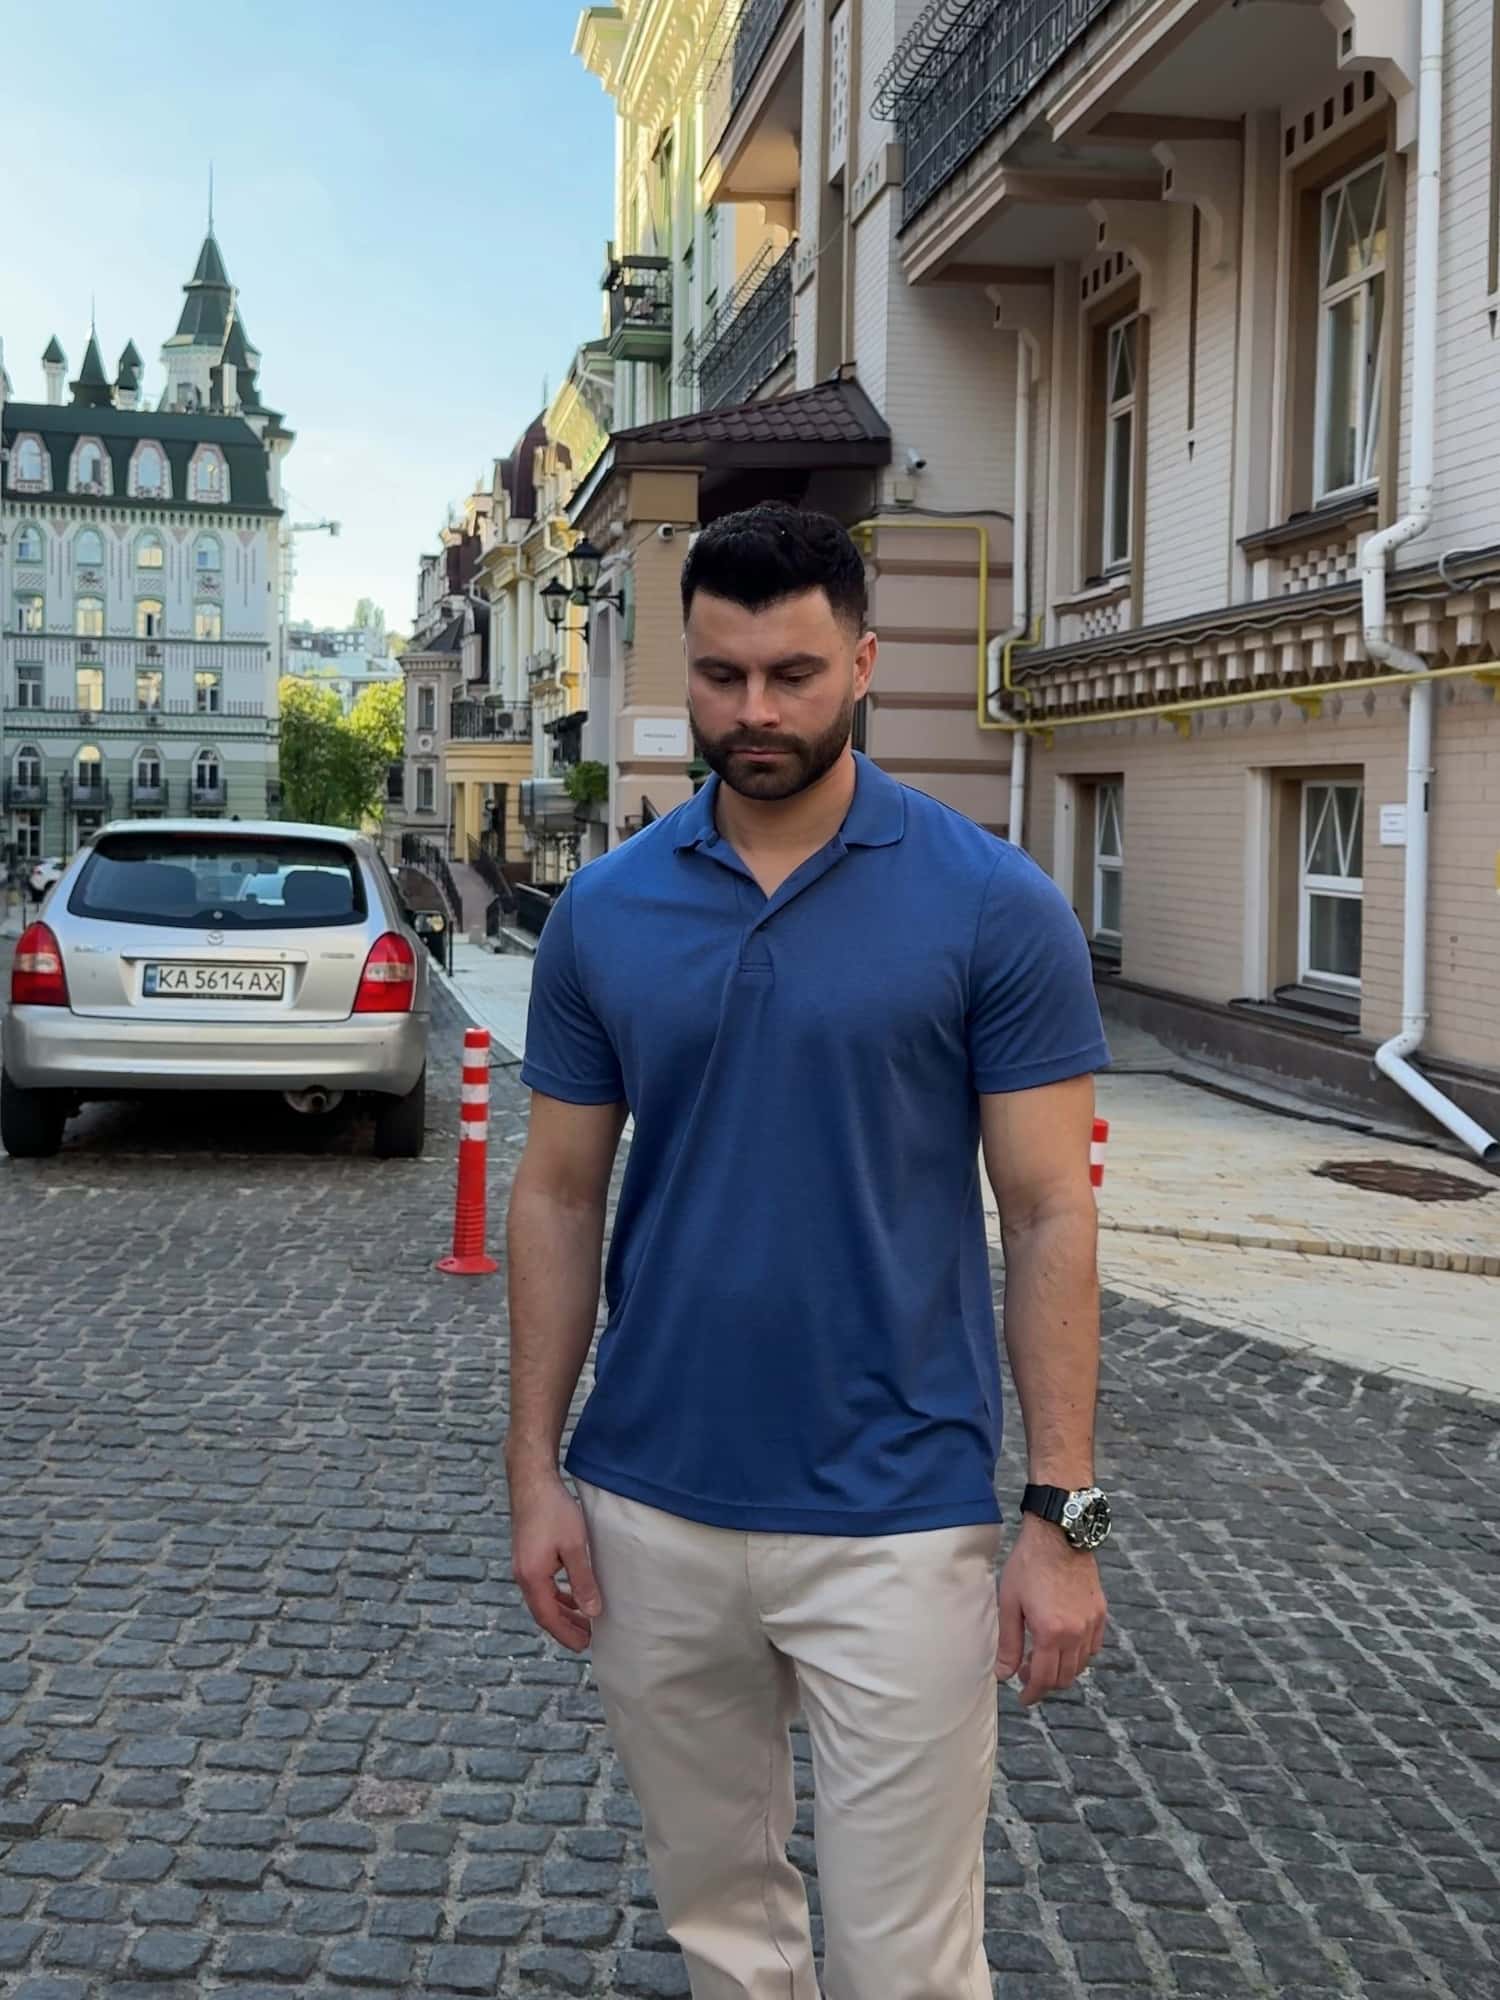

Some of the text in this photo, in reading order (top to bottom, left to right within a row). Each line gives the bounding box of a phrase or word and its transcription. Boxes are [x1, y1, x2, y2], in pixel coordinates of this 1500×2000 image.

[158, 969, 278, 991] KA 5614 AX
